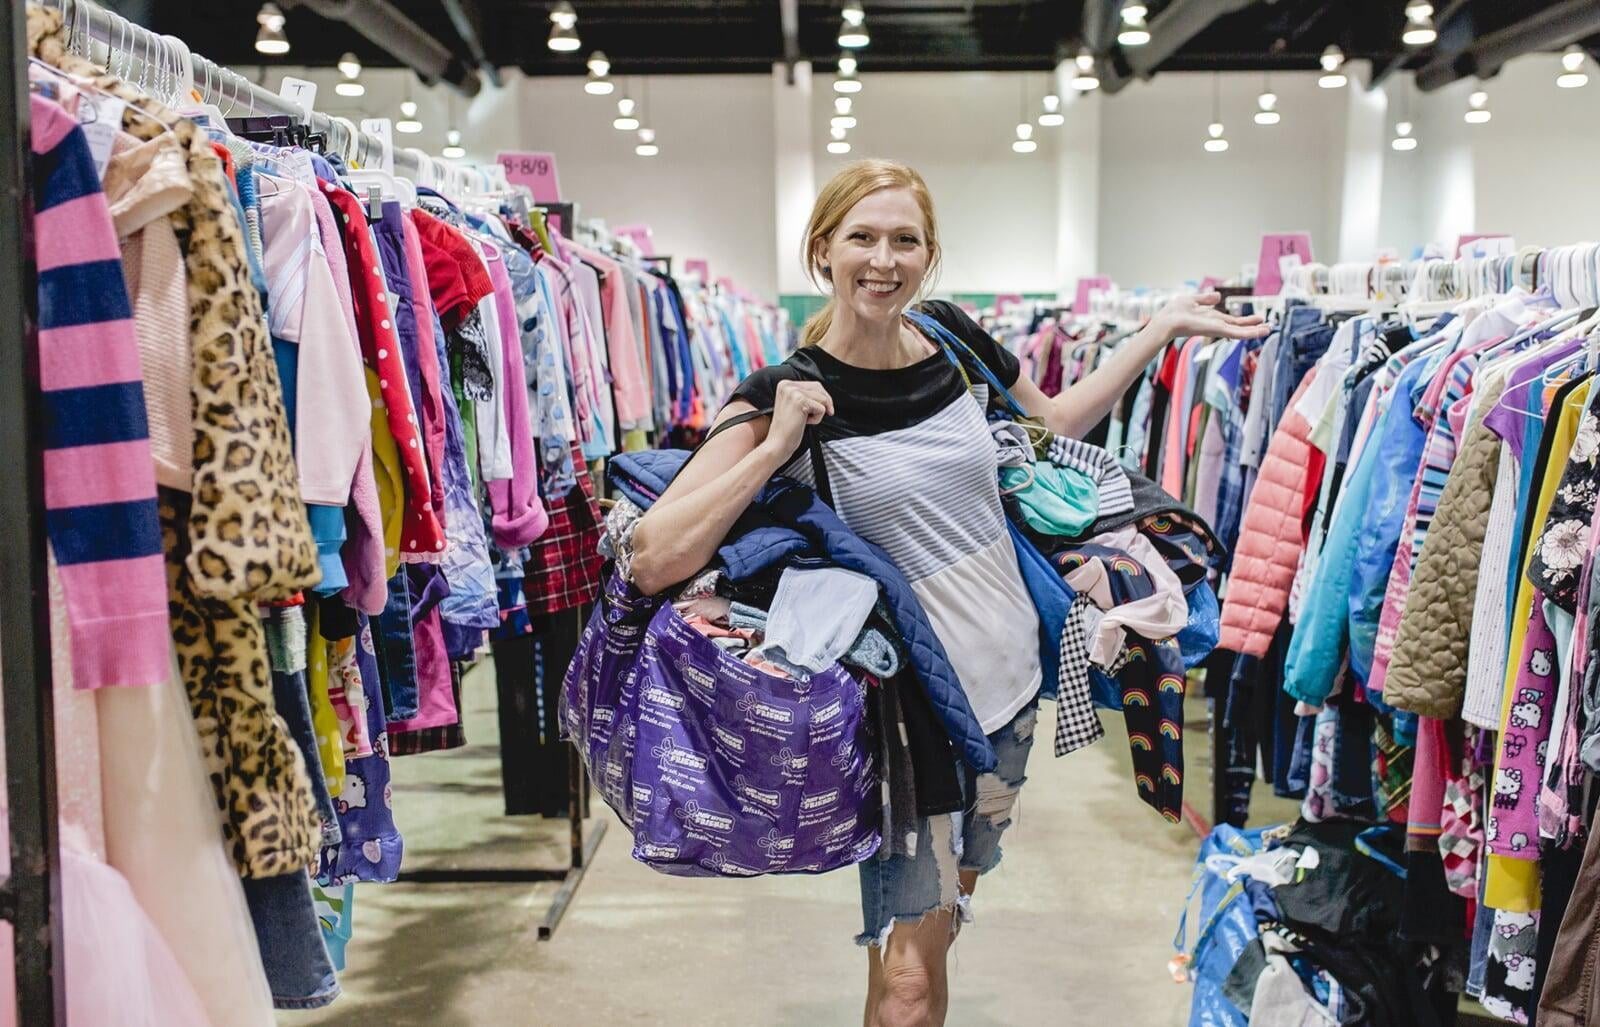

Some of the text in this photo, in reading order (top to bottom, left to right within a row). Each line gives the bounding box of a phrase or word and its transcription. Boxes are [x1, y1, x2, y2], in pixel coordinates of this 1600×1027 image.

[756, 709, 790, 722] FRIENDS
[670, 755, 705, 770] FRIENDS
[660, 774, 696, 792] jbfsale.com
[695, 817, 731, 830] FRIENDS
